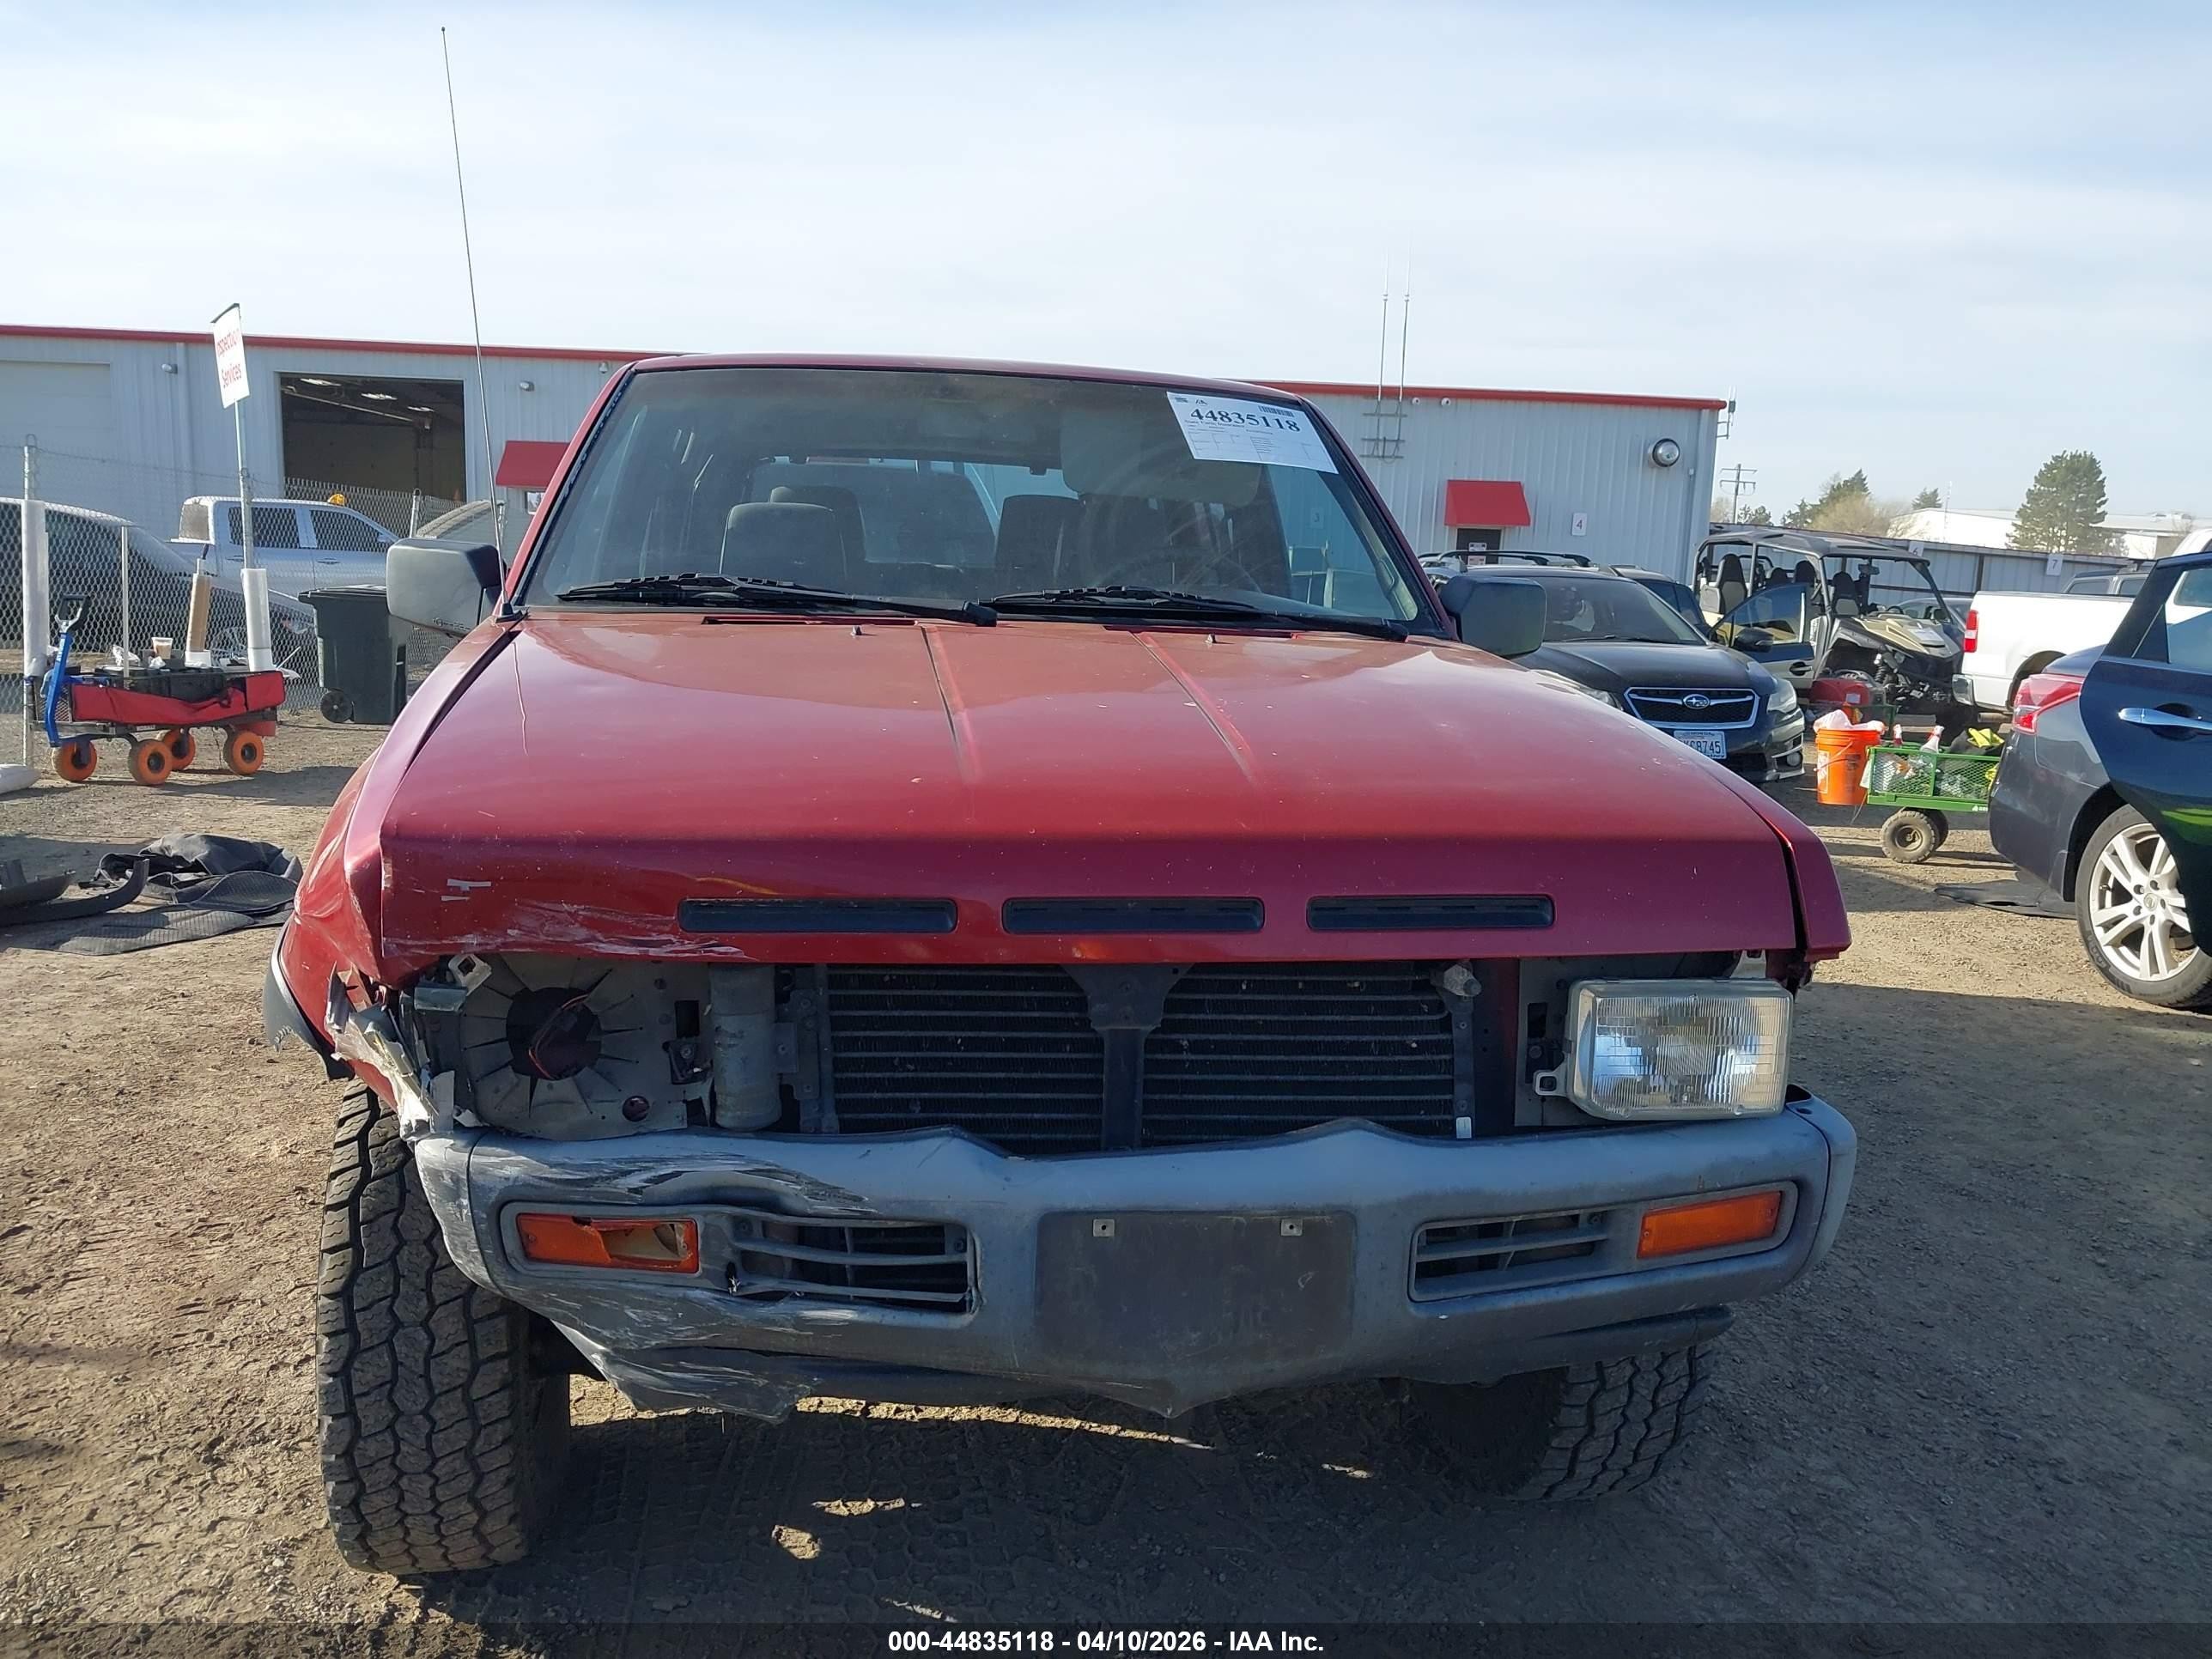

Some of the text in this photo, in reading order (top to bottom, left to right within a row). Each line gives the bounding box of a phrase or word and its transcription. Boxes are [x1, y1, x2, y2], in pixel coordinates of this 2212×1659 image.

[222, 363, 242, 389] Services
[1190, 408, 1301, 432] 44835118
[1576, 519, 1583, 530] 4
[2051, 559, 2058, 569] 7
